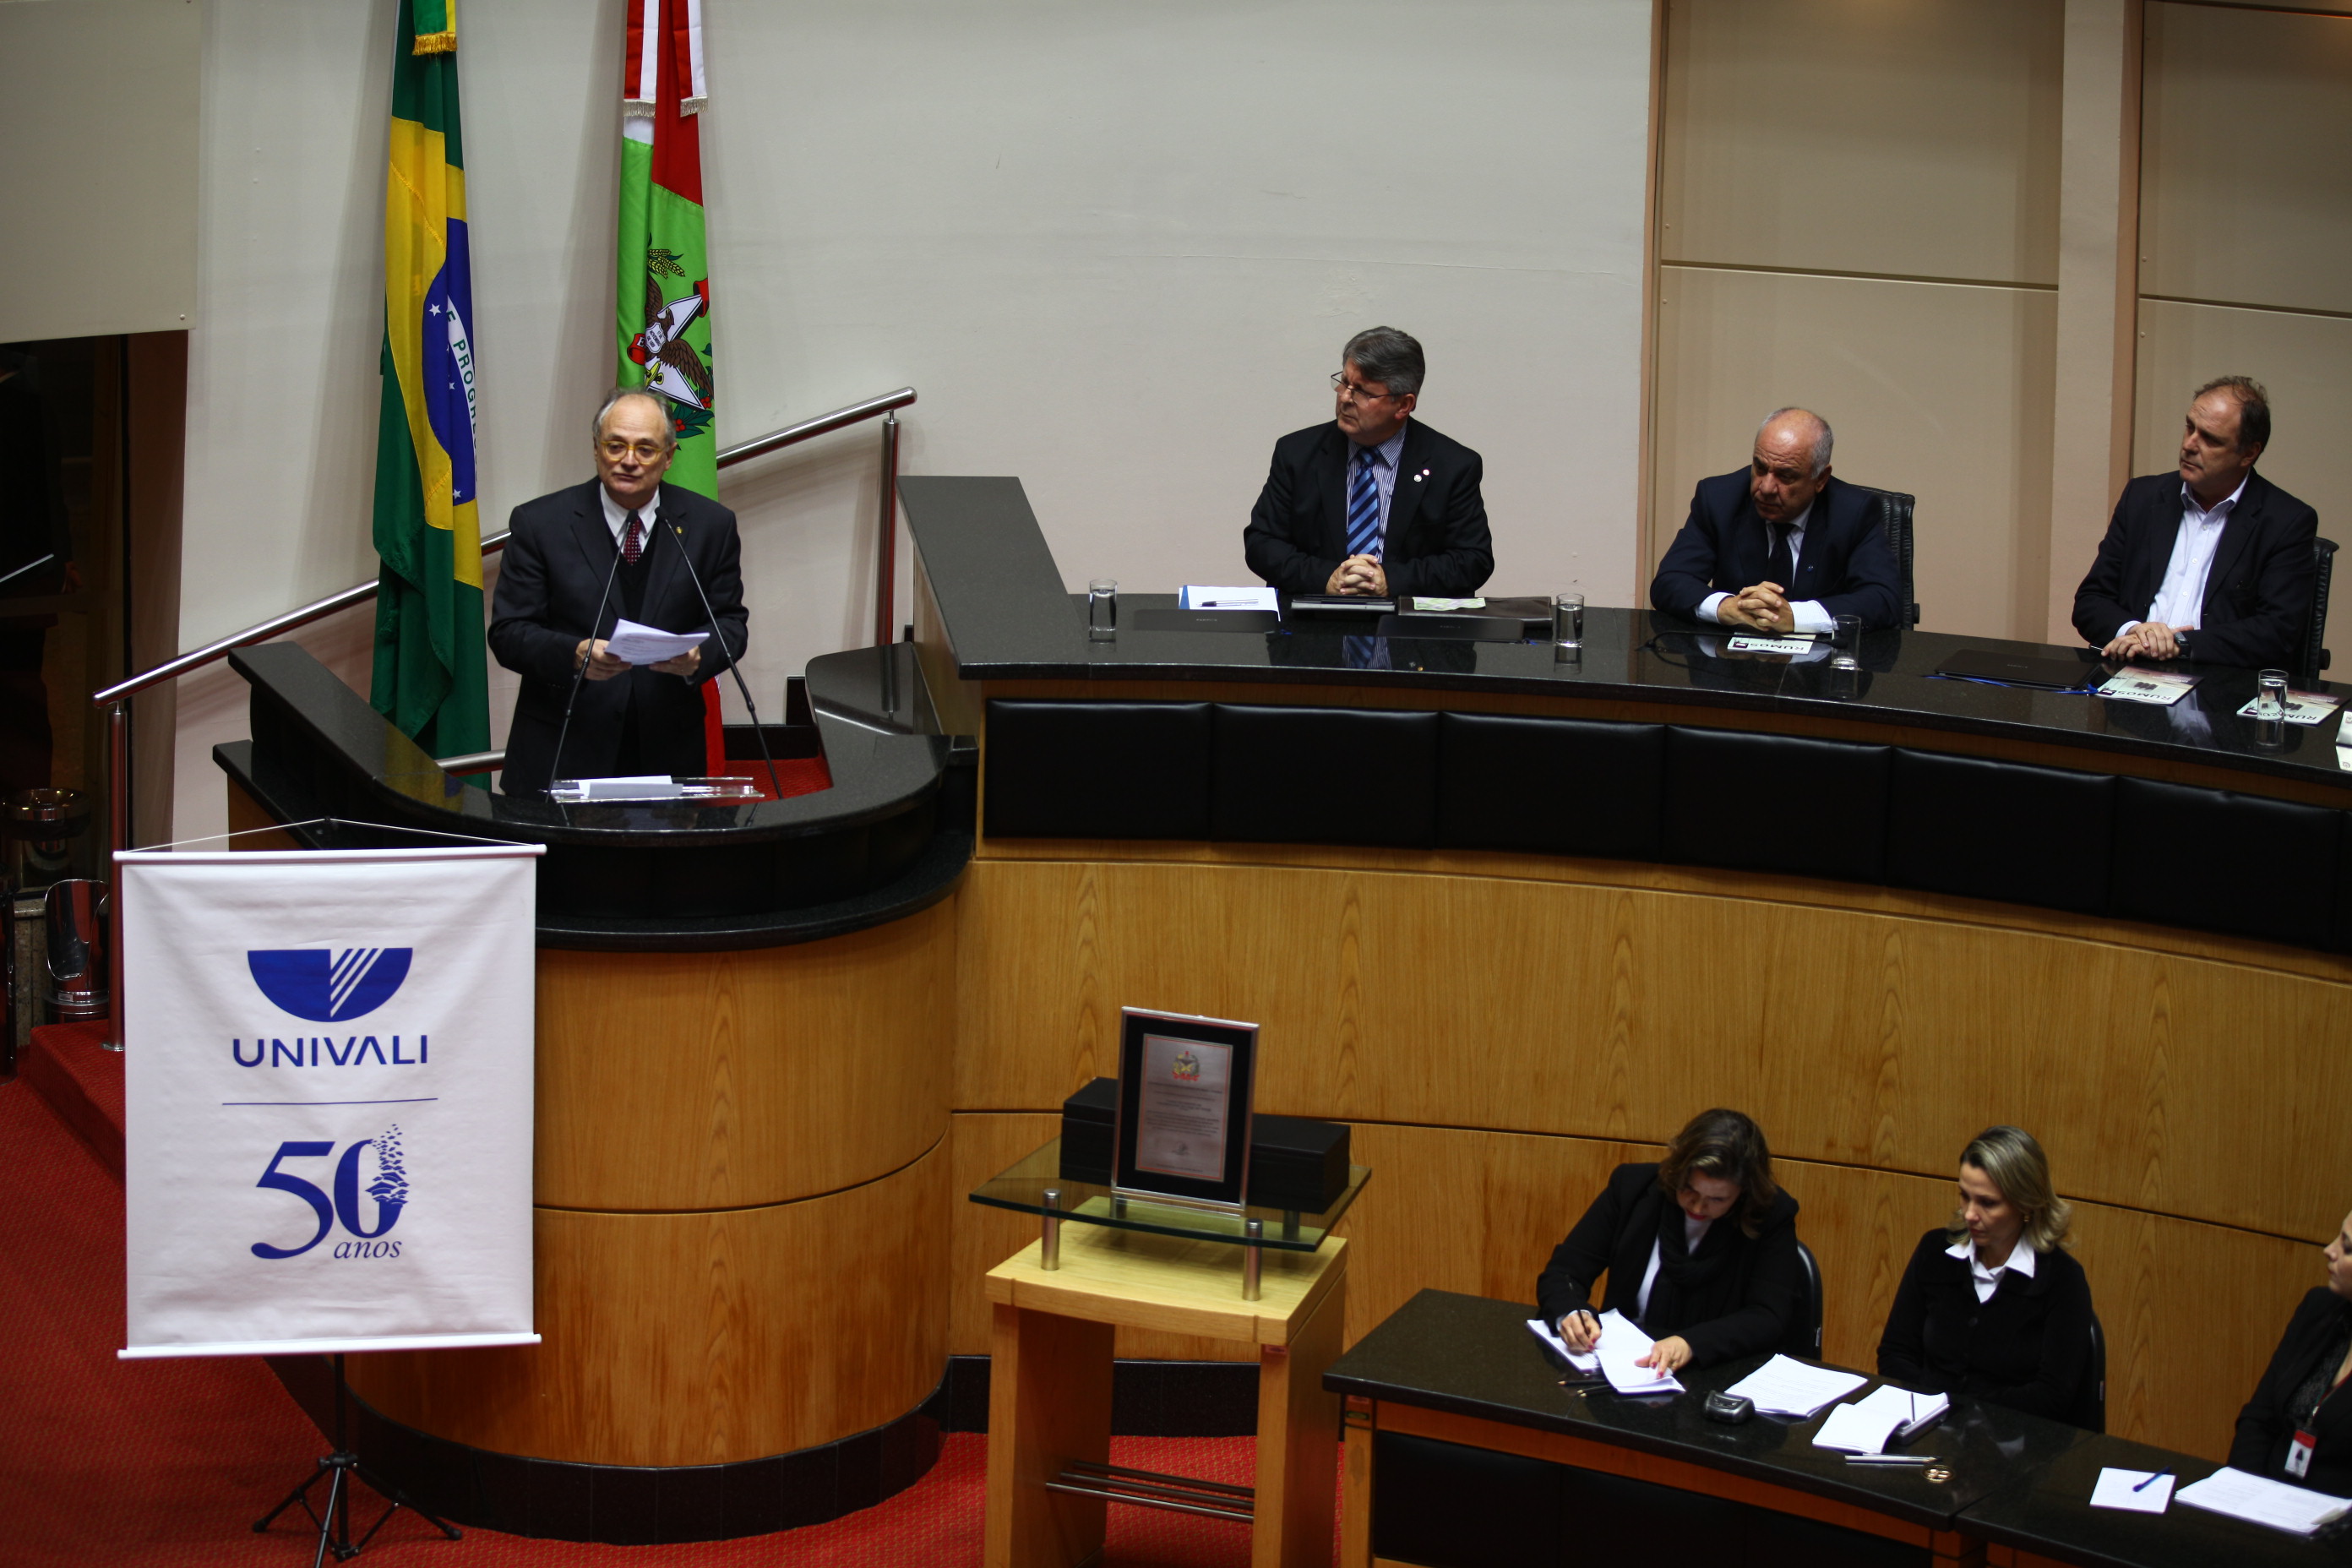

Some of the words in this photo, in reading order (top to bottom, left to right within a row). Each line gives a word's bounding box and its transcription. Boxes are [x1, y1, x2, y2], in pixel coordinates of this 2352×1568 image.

[232, 1034, 428, 1068] UNIVALI
[250, 1132, 411, 1260] 50
[333, 1238, 402, 1260] anos
